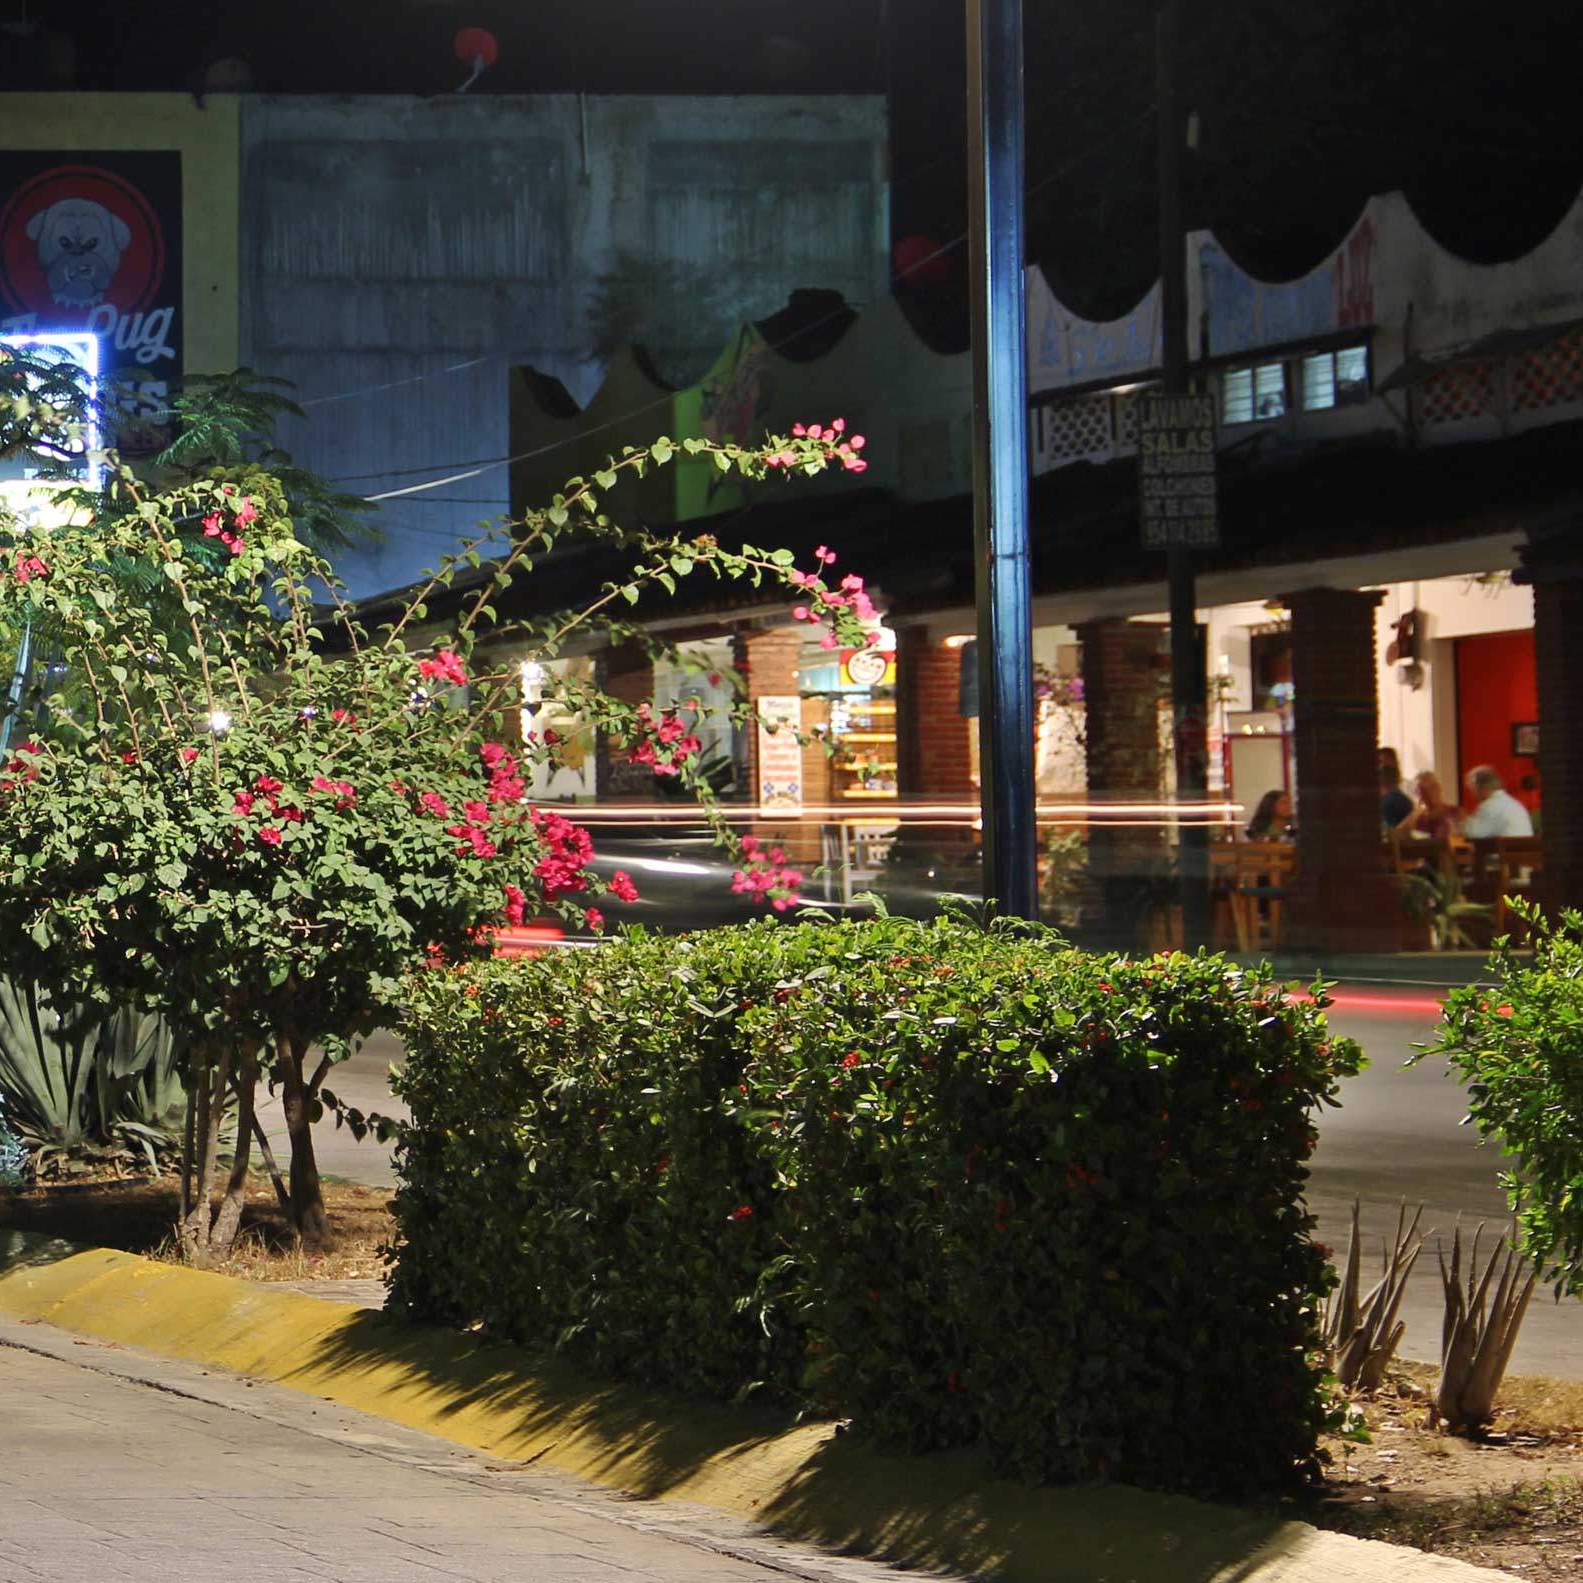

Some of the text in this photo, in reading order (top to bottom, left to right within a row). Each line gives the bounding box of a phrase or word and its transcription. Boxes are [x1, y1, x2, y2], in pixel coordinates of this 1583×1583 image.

[86, 304, 176, 364] Pug
[1141, 398, 1213, 429] LAVAMOS
[1141, 431, 1214, 454] SALAS
